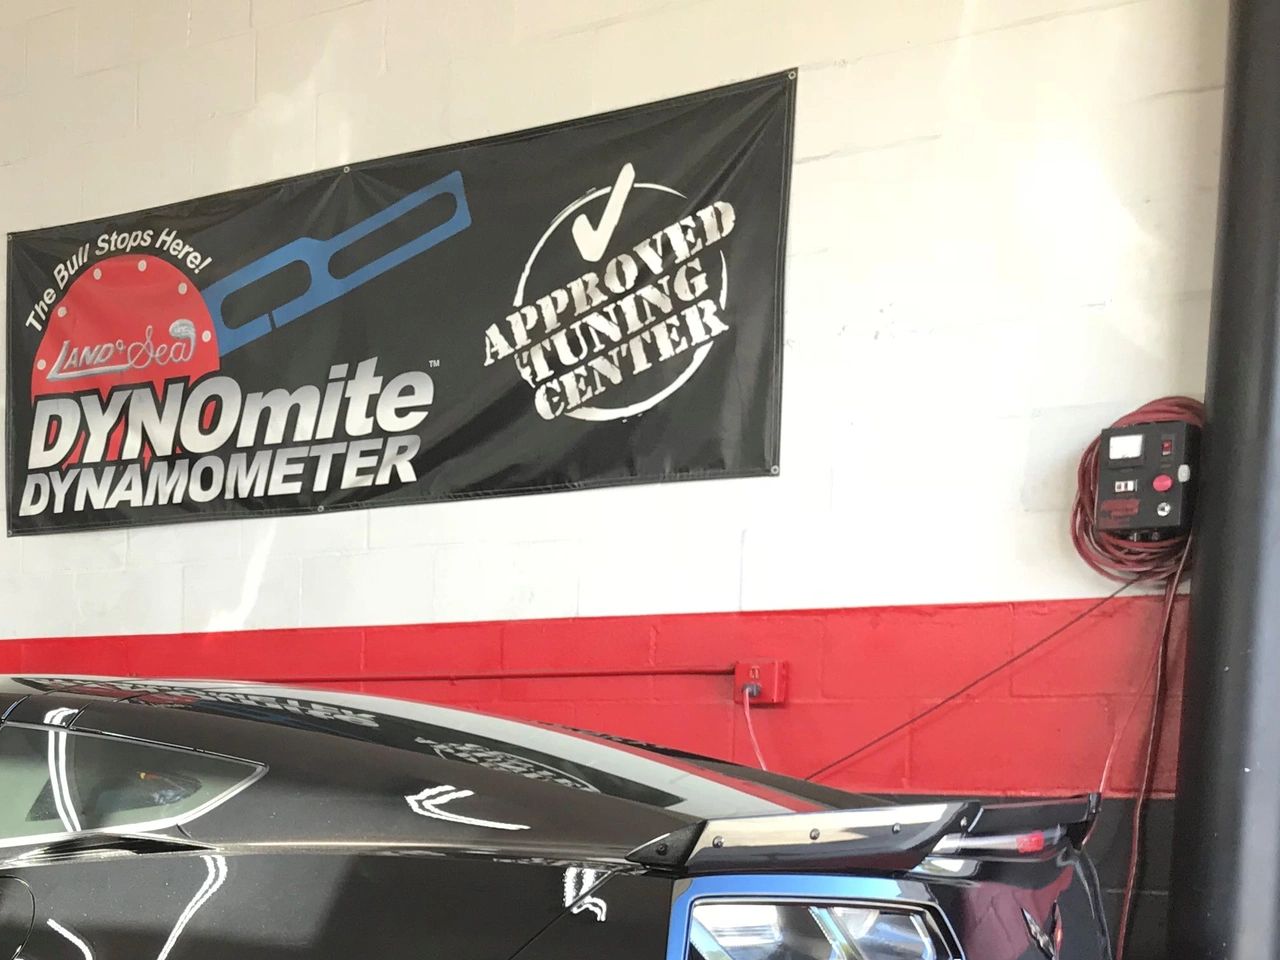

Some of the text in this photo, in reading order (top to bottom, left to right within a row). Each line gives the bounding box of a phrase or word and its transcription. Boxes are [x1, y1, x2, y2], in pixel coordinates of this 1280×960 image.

[25, 228, 212, 332] The Bull Stops Here!
[484, 201, 736, 366] APPROVED
[523, 258, 709, 382] TUNING
[127, 319, 196, 369] Sea
[534, 299, 729, 420] CENTER
[28, 356, 440, 469] DYNOmite TM
[18, 434, 422, 516] DYNAMOMETER
